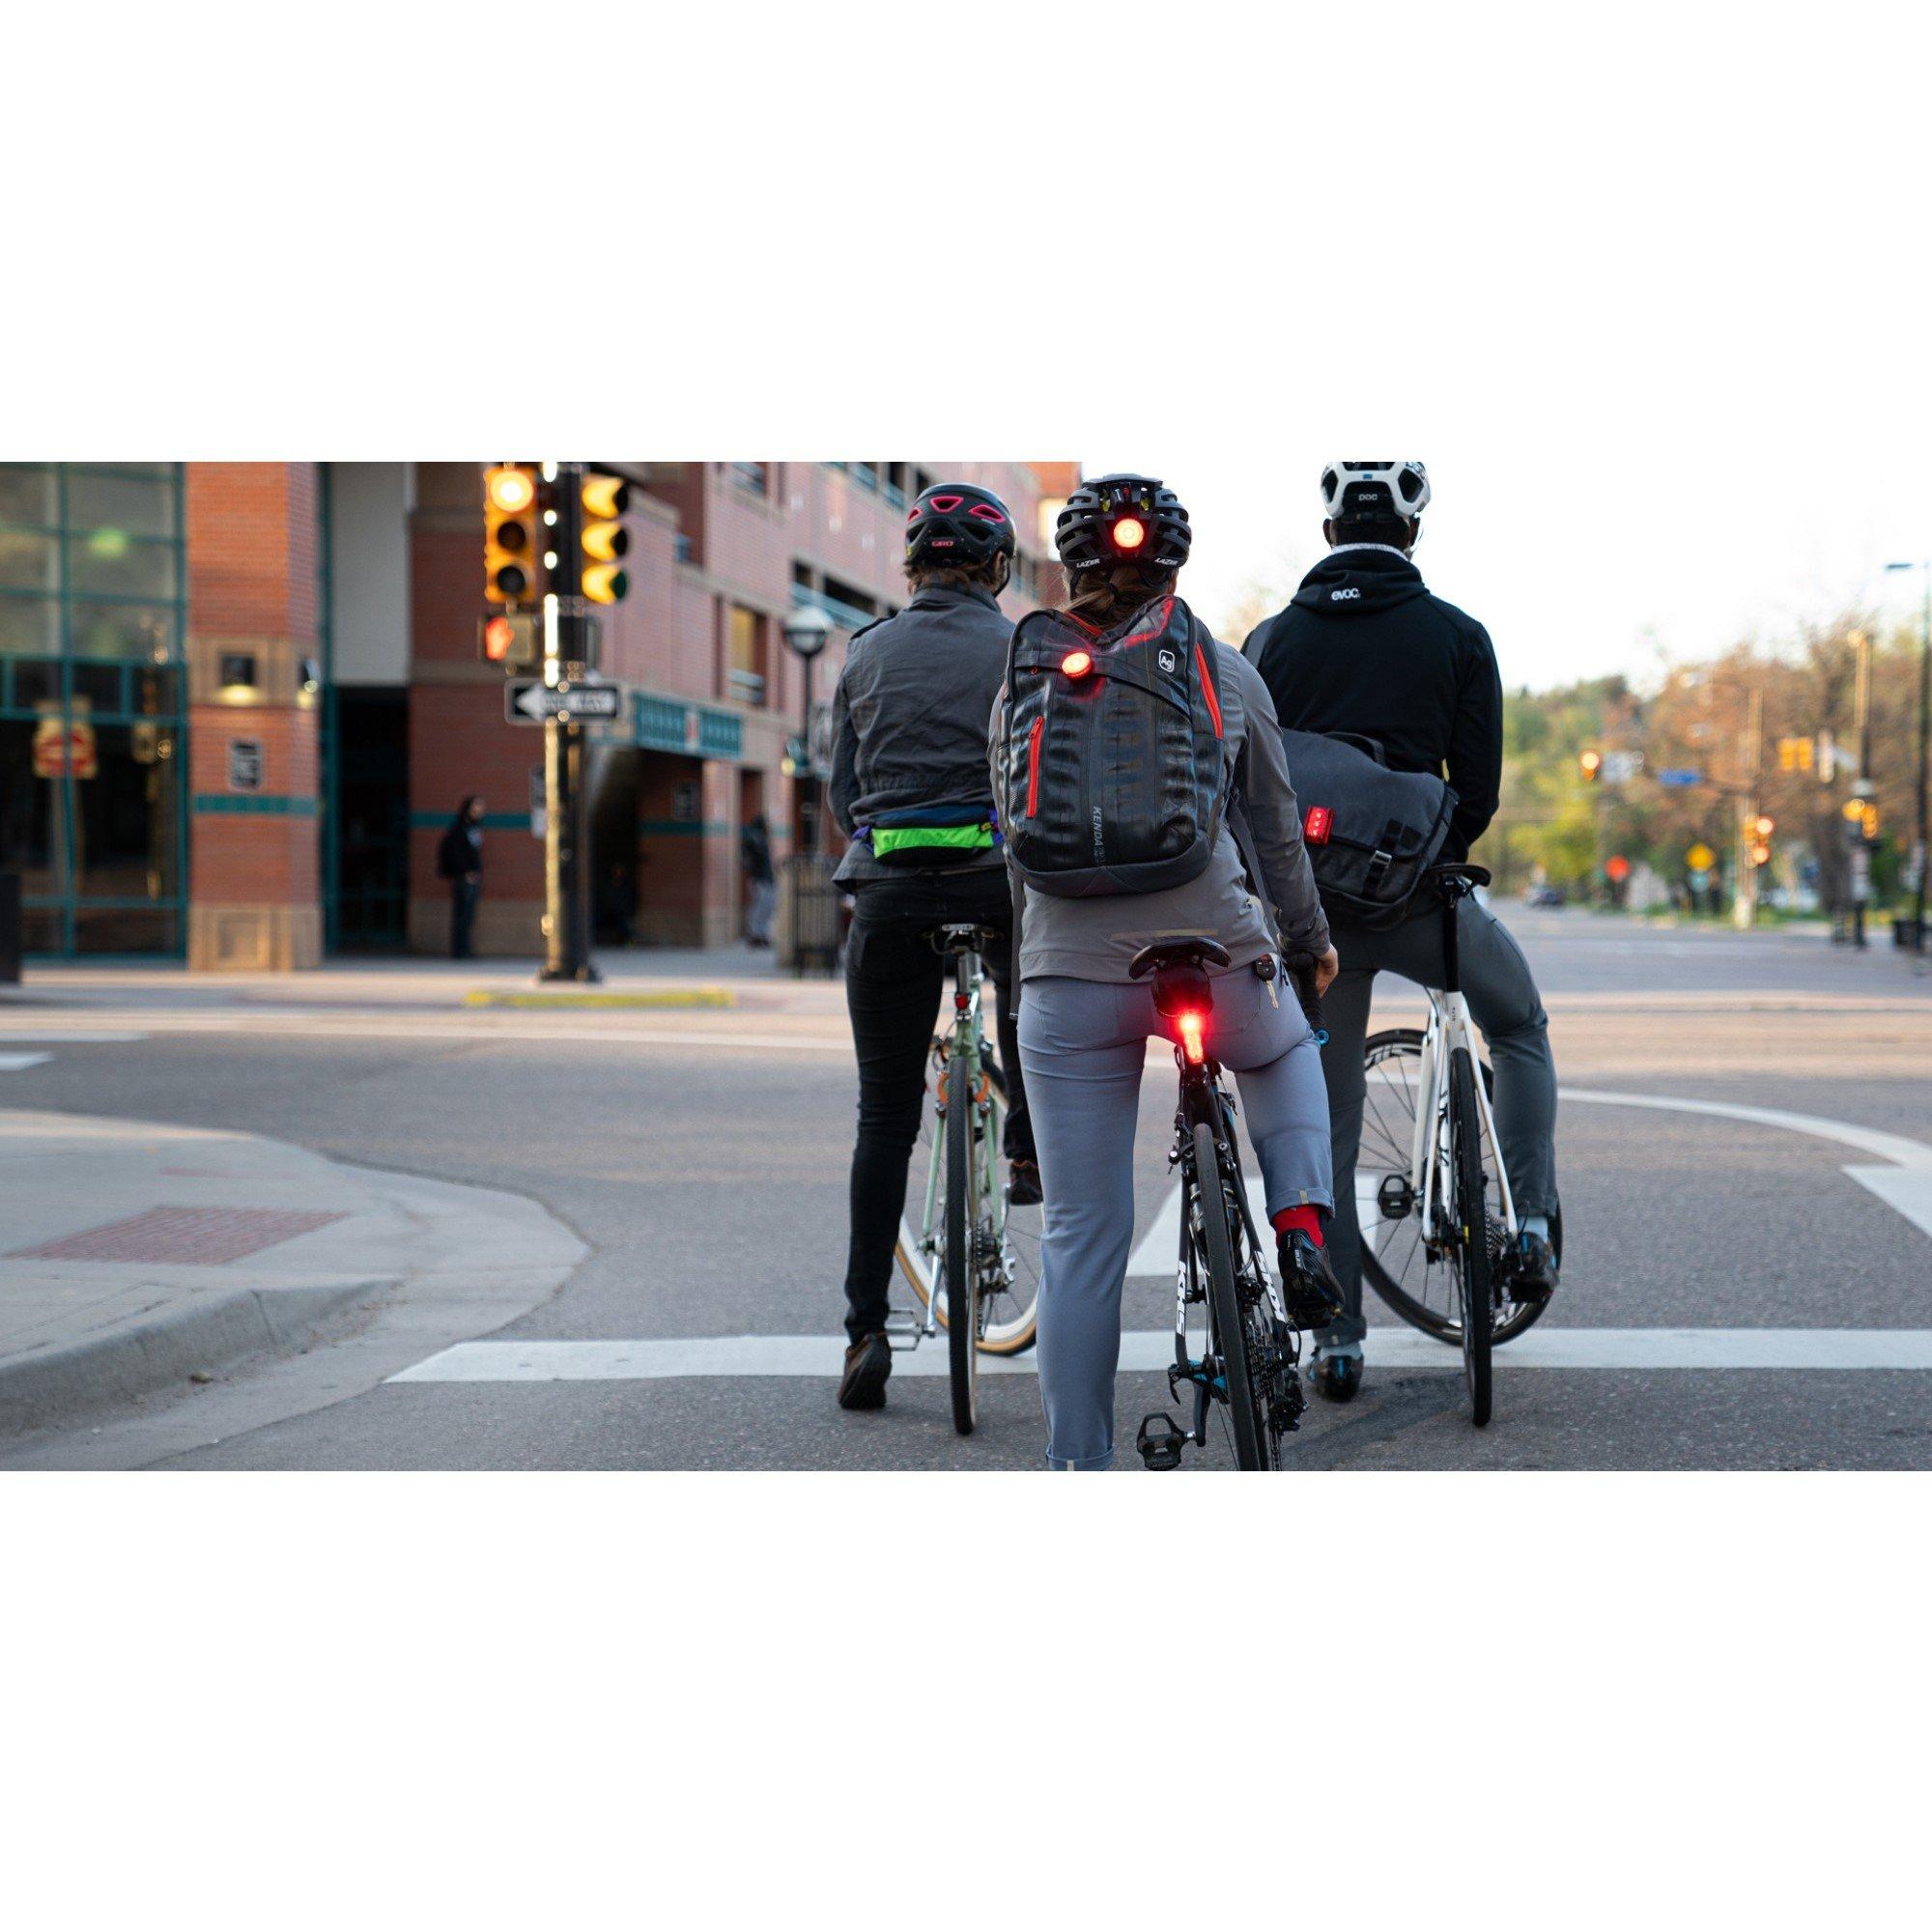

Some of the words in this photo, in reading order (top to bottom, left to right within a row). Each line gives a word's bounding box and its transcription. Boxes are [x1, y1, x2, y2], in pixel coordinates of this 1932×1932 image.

[1076, 558, 1100, 568] LAZER
[1153, 557, 1179, 566] LAZER
[1160, 655, 1173, 670] Ag
[1093, 806, 1103, 846] KENDA
